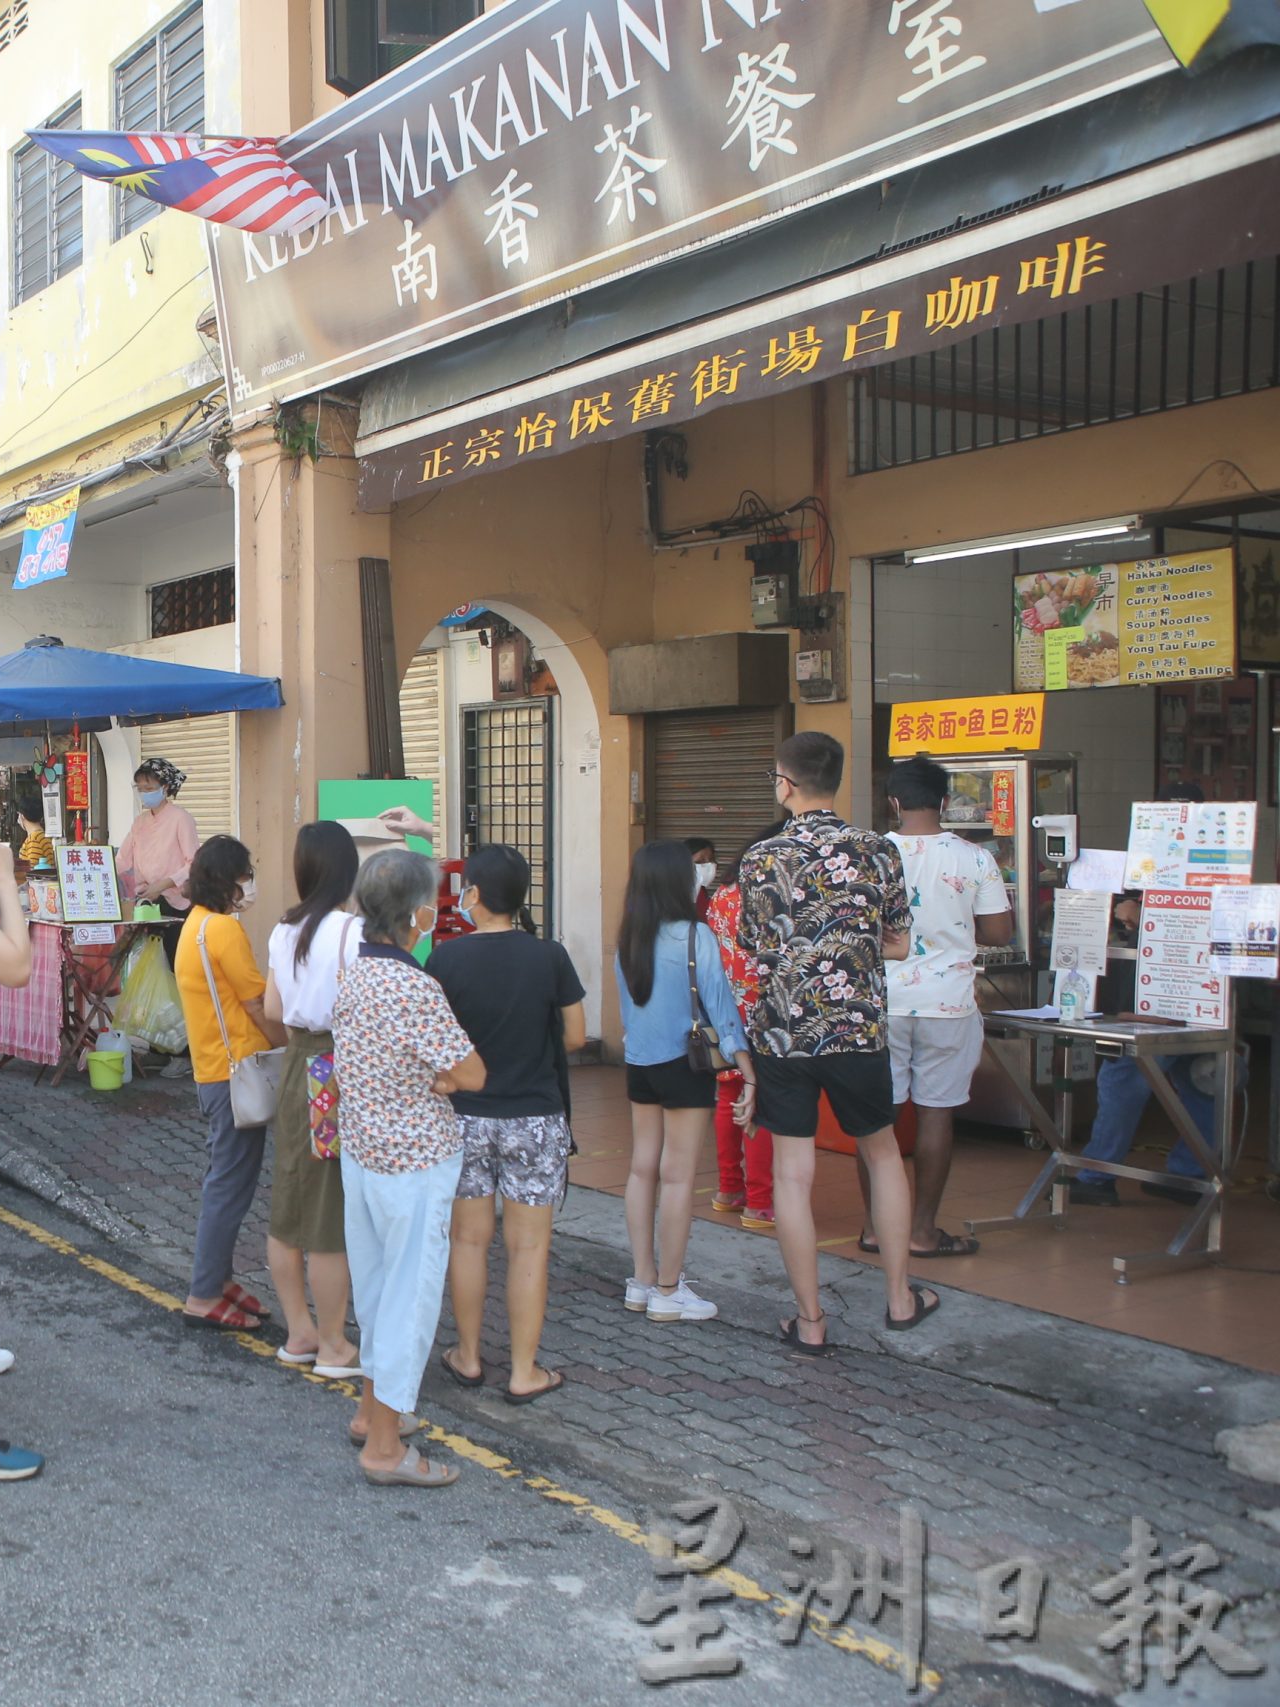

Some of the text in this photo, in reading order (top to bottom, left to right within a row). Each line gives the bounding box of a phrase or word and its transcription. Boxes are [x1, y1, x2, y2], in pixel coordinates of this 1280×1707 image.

[379, 0, 670, 215] MAKANAN
[1127, 563, 1213, 580] Hakka Noodles
[1095, 572, 1116, 611] 早市
[1126, 590, 1213, 606] Curry Noodles
[1127, 614, 1210, 630] Soup Noodles
[1127, 640, 1216, 654] Yong Tau Fu/pc
[1128, 670, 1152, 680] Fish
[1156, 669, 1184, 678] Meat
[1148, 894, 1171, 905] SOP
